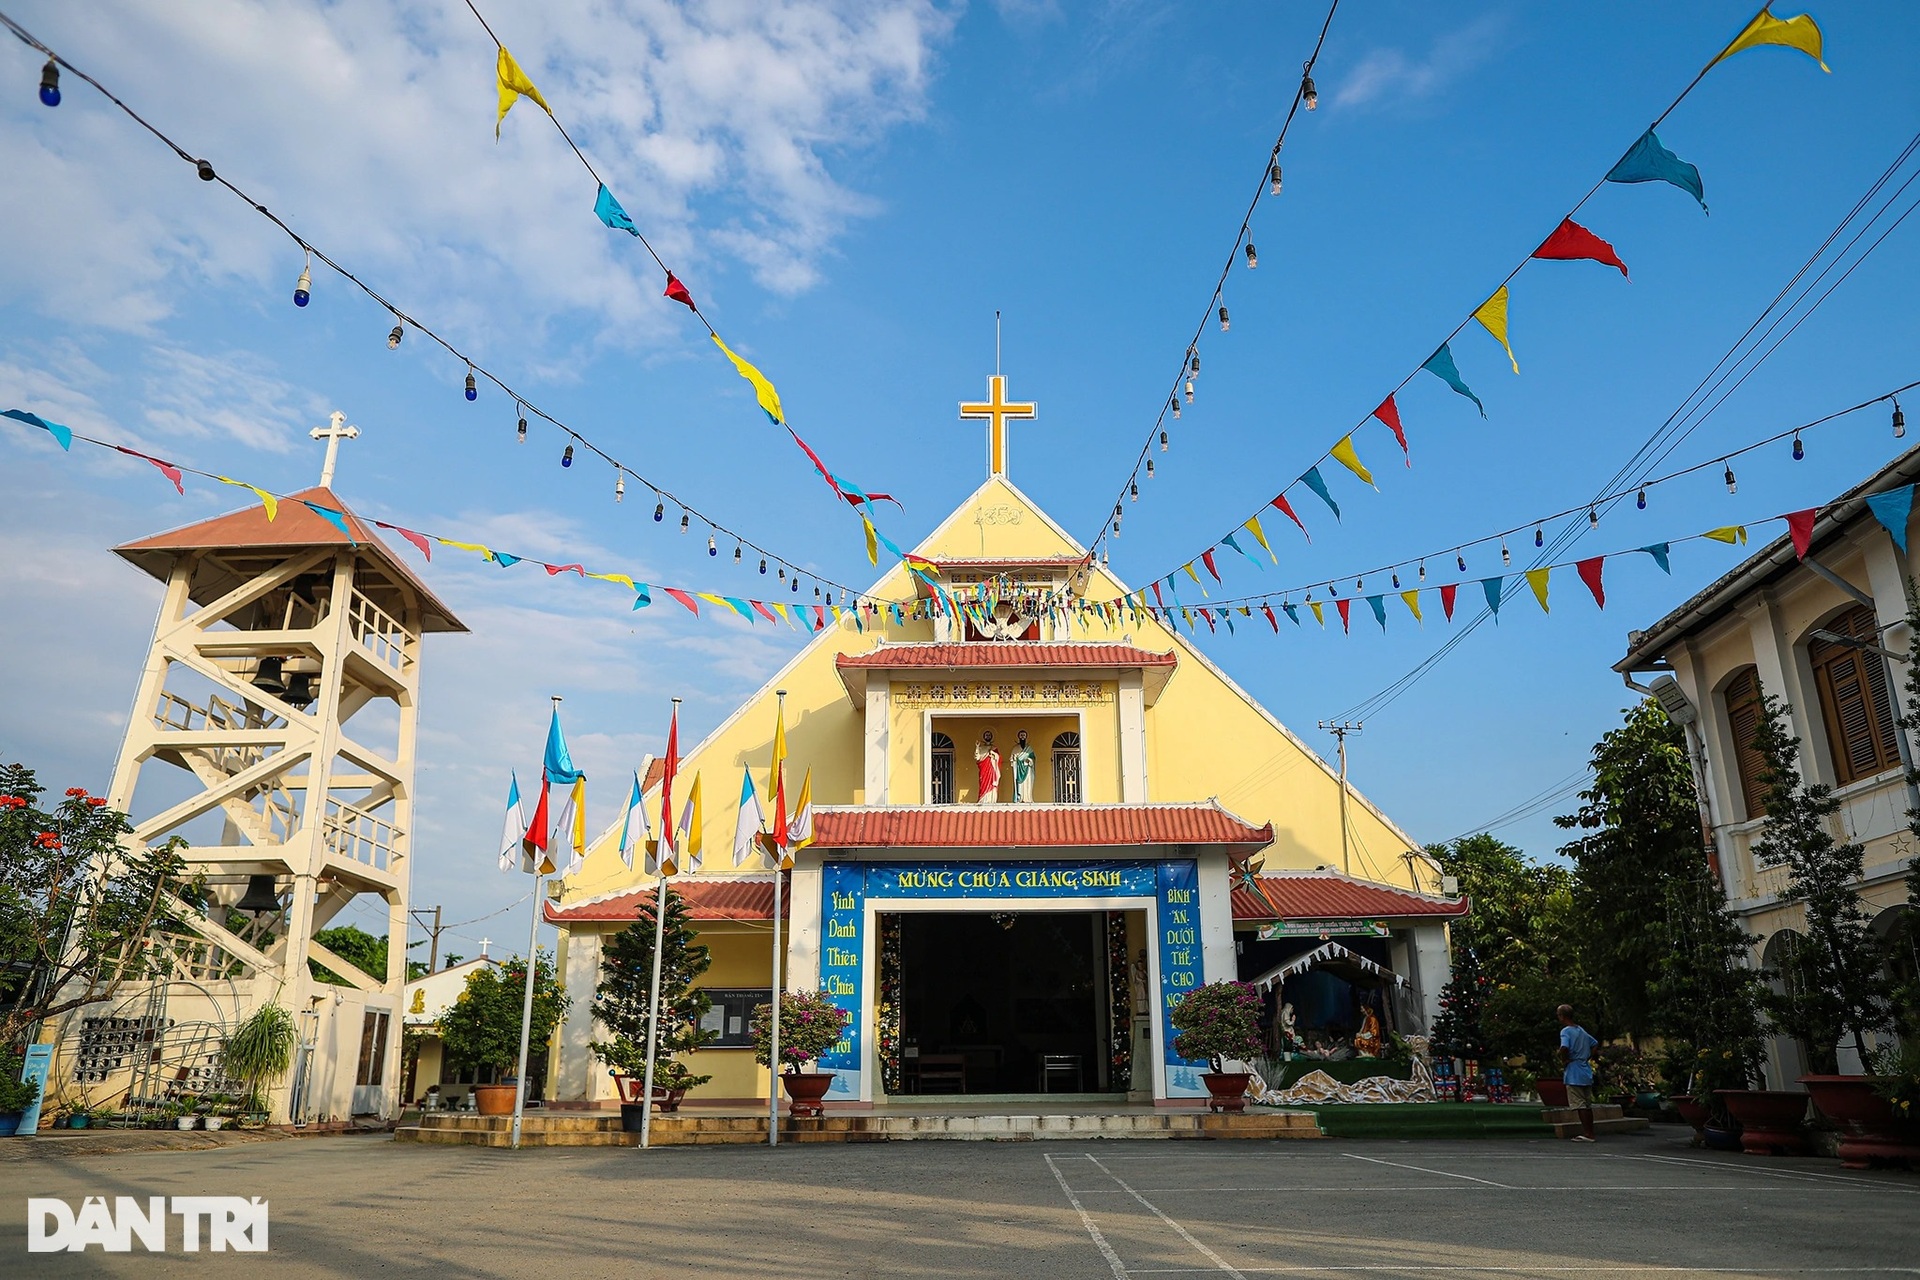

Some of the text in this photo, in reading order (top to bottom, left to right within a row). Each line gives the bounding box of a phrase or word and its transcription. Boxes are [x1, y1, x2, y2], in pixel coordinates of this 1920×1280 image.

[898, 867, 1122, 888] MỪNG CHÚA GIÁNG SINH
[831, 890, 855, 911] Vinh
[1172, 910, 1187, 924] AN
[828, 918, 856, 938] Danh
[1167, 927, 1195, 945] DƯỚI
[826, 946, 858, 967] Thiên
[827, 974, 855, 995] Chúa
[1171, 971, 1195, 987] CHO
